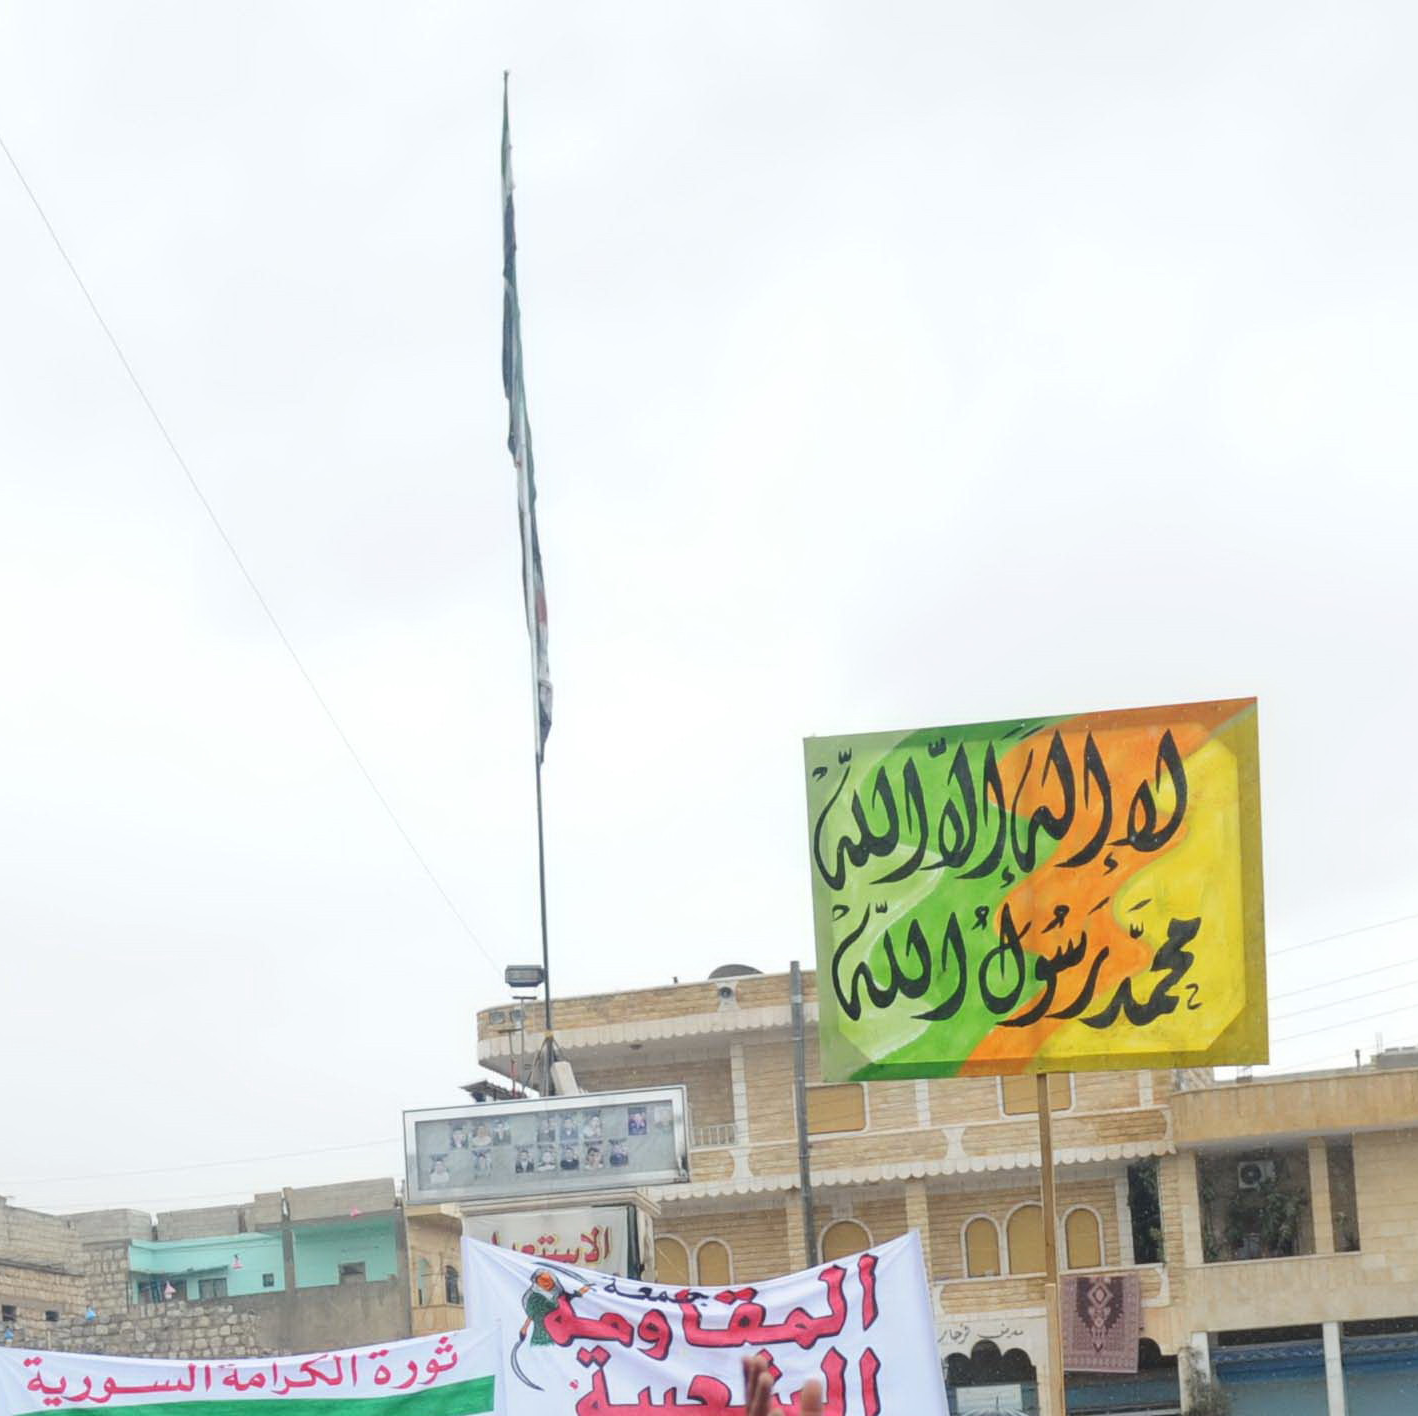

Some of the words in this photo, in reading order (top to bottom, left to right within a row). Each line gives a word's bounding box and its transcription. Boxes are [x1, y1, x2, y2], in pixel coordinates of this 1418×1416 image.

[812, 747, 929, 892] الله
[831, 900, 968, 1022] الله
[603, 1275, 709, 1307] جمعة
[23, 1355, 211, 1407] السورية
[219, 1354, 358, 1395] الكرامة
[366, 1335, 459, 1389] ثورة
